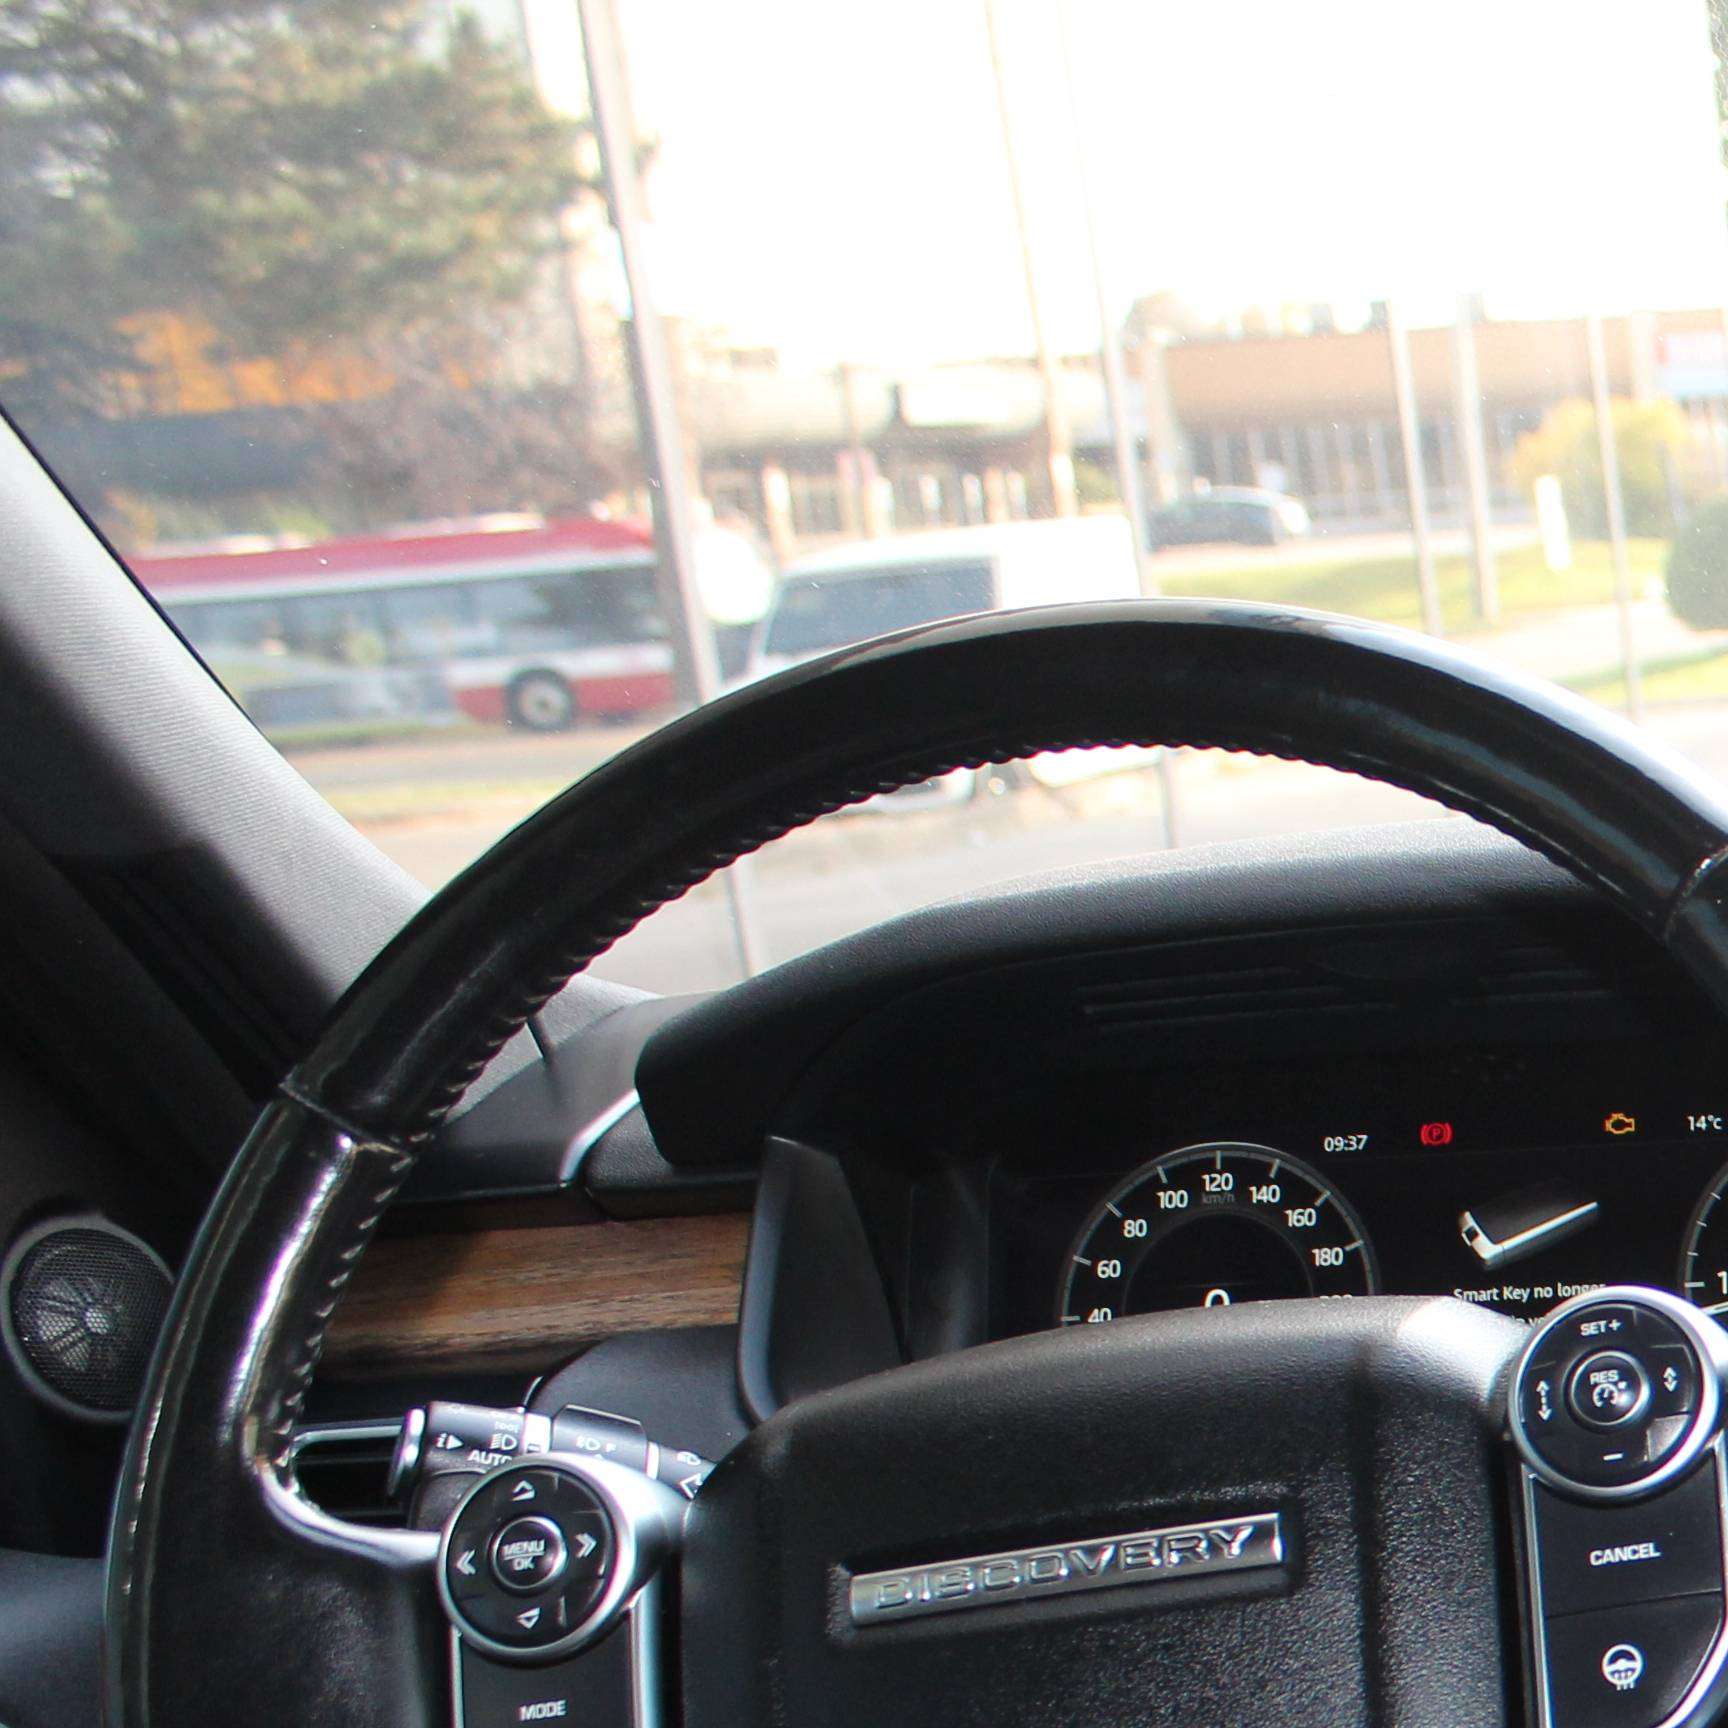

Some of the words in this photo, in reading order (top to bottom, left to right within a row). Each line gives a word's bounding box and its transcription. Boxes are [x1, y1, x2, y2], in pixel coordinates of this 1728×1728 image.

[1324, 1135, 1368, 1152] 09:37
[1202, 1173, 1233, 1191] 120
[1156, 1190, 1188, 1209] 100
[1250, 1184, 1280, 1203] 140
[1284, 1209, 1316, 1228] 160
[1123, 1219, 1147, 1238] 80
[1312, 1247, 1343, 1266] 180
[1097, 1260, 1121, 1279] 60
[1717, 1270, 1728, 1295] 1
[1453, 1288, 1499, 1302] Smart
[1502, 1286, 1530, 1303] Key
[1534, 1286, 1553, 1298] no
[1087, 1308, 1112, 1323] 40
[1589, 1369, 1619, 1385] RES
[502, 1540, 545, 1554] MENU
[1589, 1542, 1661, 1566] CANCEL
[512, 1557, 535, 1571] OK
[874, 1525, 1253, 1608] DISCOVERY
[518, 1699, 567, 1721] MODE
